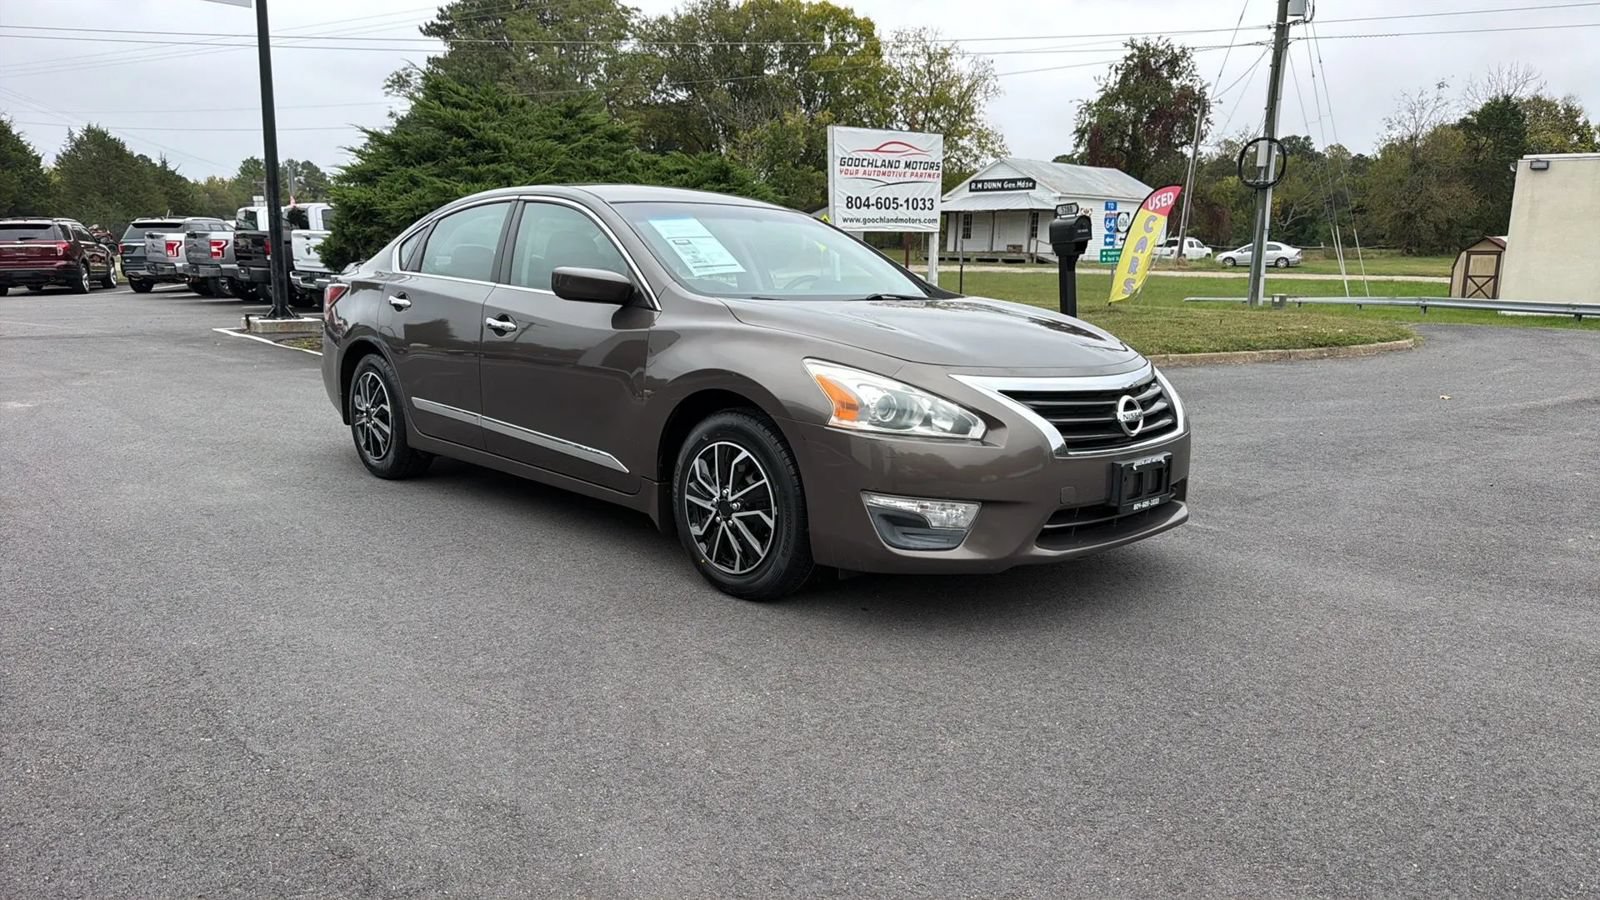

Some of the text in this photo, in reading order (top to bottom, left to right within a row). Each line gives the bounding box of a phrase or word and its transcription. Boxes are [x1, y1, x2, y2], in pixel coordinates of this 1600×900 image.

[840, 157, 940, 171] GOOCHLAND MOTORS
[862, 170, 907, 178] AUTOMOTIVE
[845, 196, 935, 211] 804-605-1033
[1148, 192, 1174, 210] USED
[842, 216, 938, 225] www.goochlandmotors.com
[1105, 218, 1115, 228] 64
[1122, 215, 1158, 295] CARS
